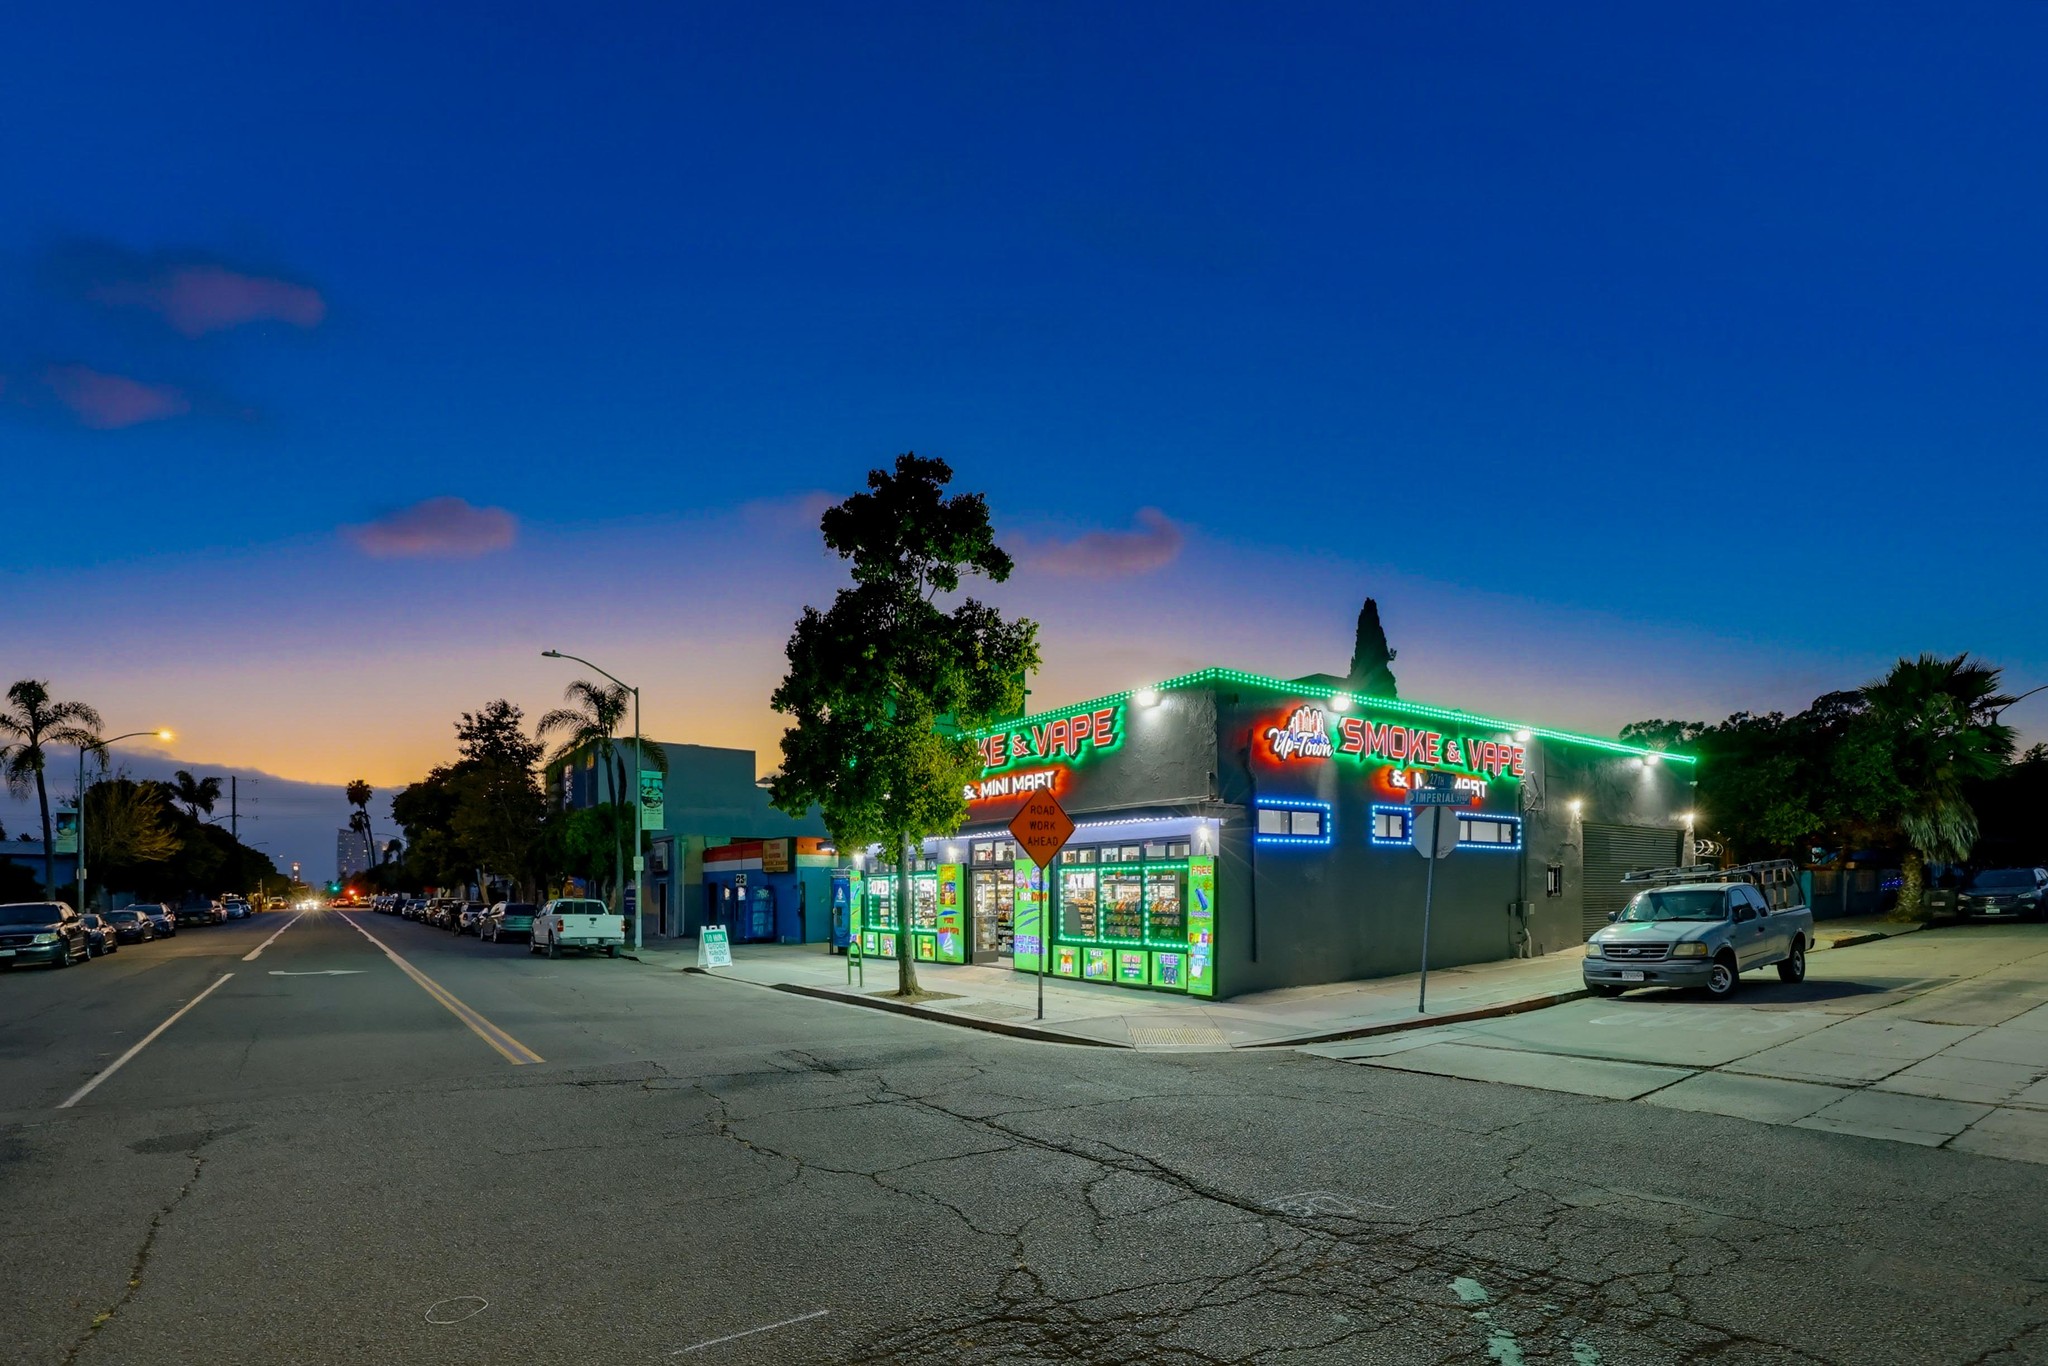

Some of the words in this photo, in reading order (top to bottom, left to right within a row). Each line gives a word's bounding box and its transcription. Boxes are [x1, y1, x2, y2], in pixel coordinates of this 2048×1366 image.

[1012, 735, 1031, 757] &
[1032, 707, 1114, 758] VAPE
[1268, 727, 1334, 760] Up-Town
[1342, 716, 1442, 766] SMOKE
[1447, 741, 1463, 764] &
[1467, 737, 1527, 777] VAPE
[963, 785, 977, 800] &
[980, 774, 1010, 799] MINI
[1012, 770, 1056, 794] MART
[1392, 770, 1410, 790] &
[1415, 791, 1455, 803] IMPERIAL
[1030, 805, 1055, 816] ROAD
[1029, 821, 1056, 831] WORK
[1027, 836, 1059, 847] AHEAD
[1191, 865, 1212, 876] FREE
